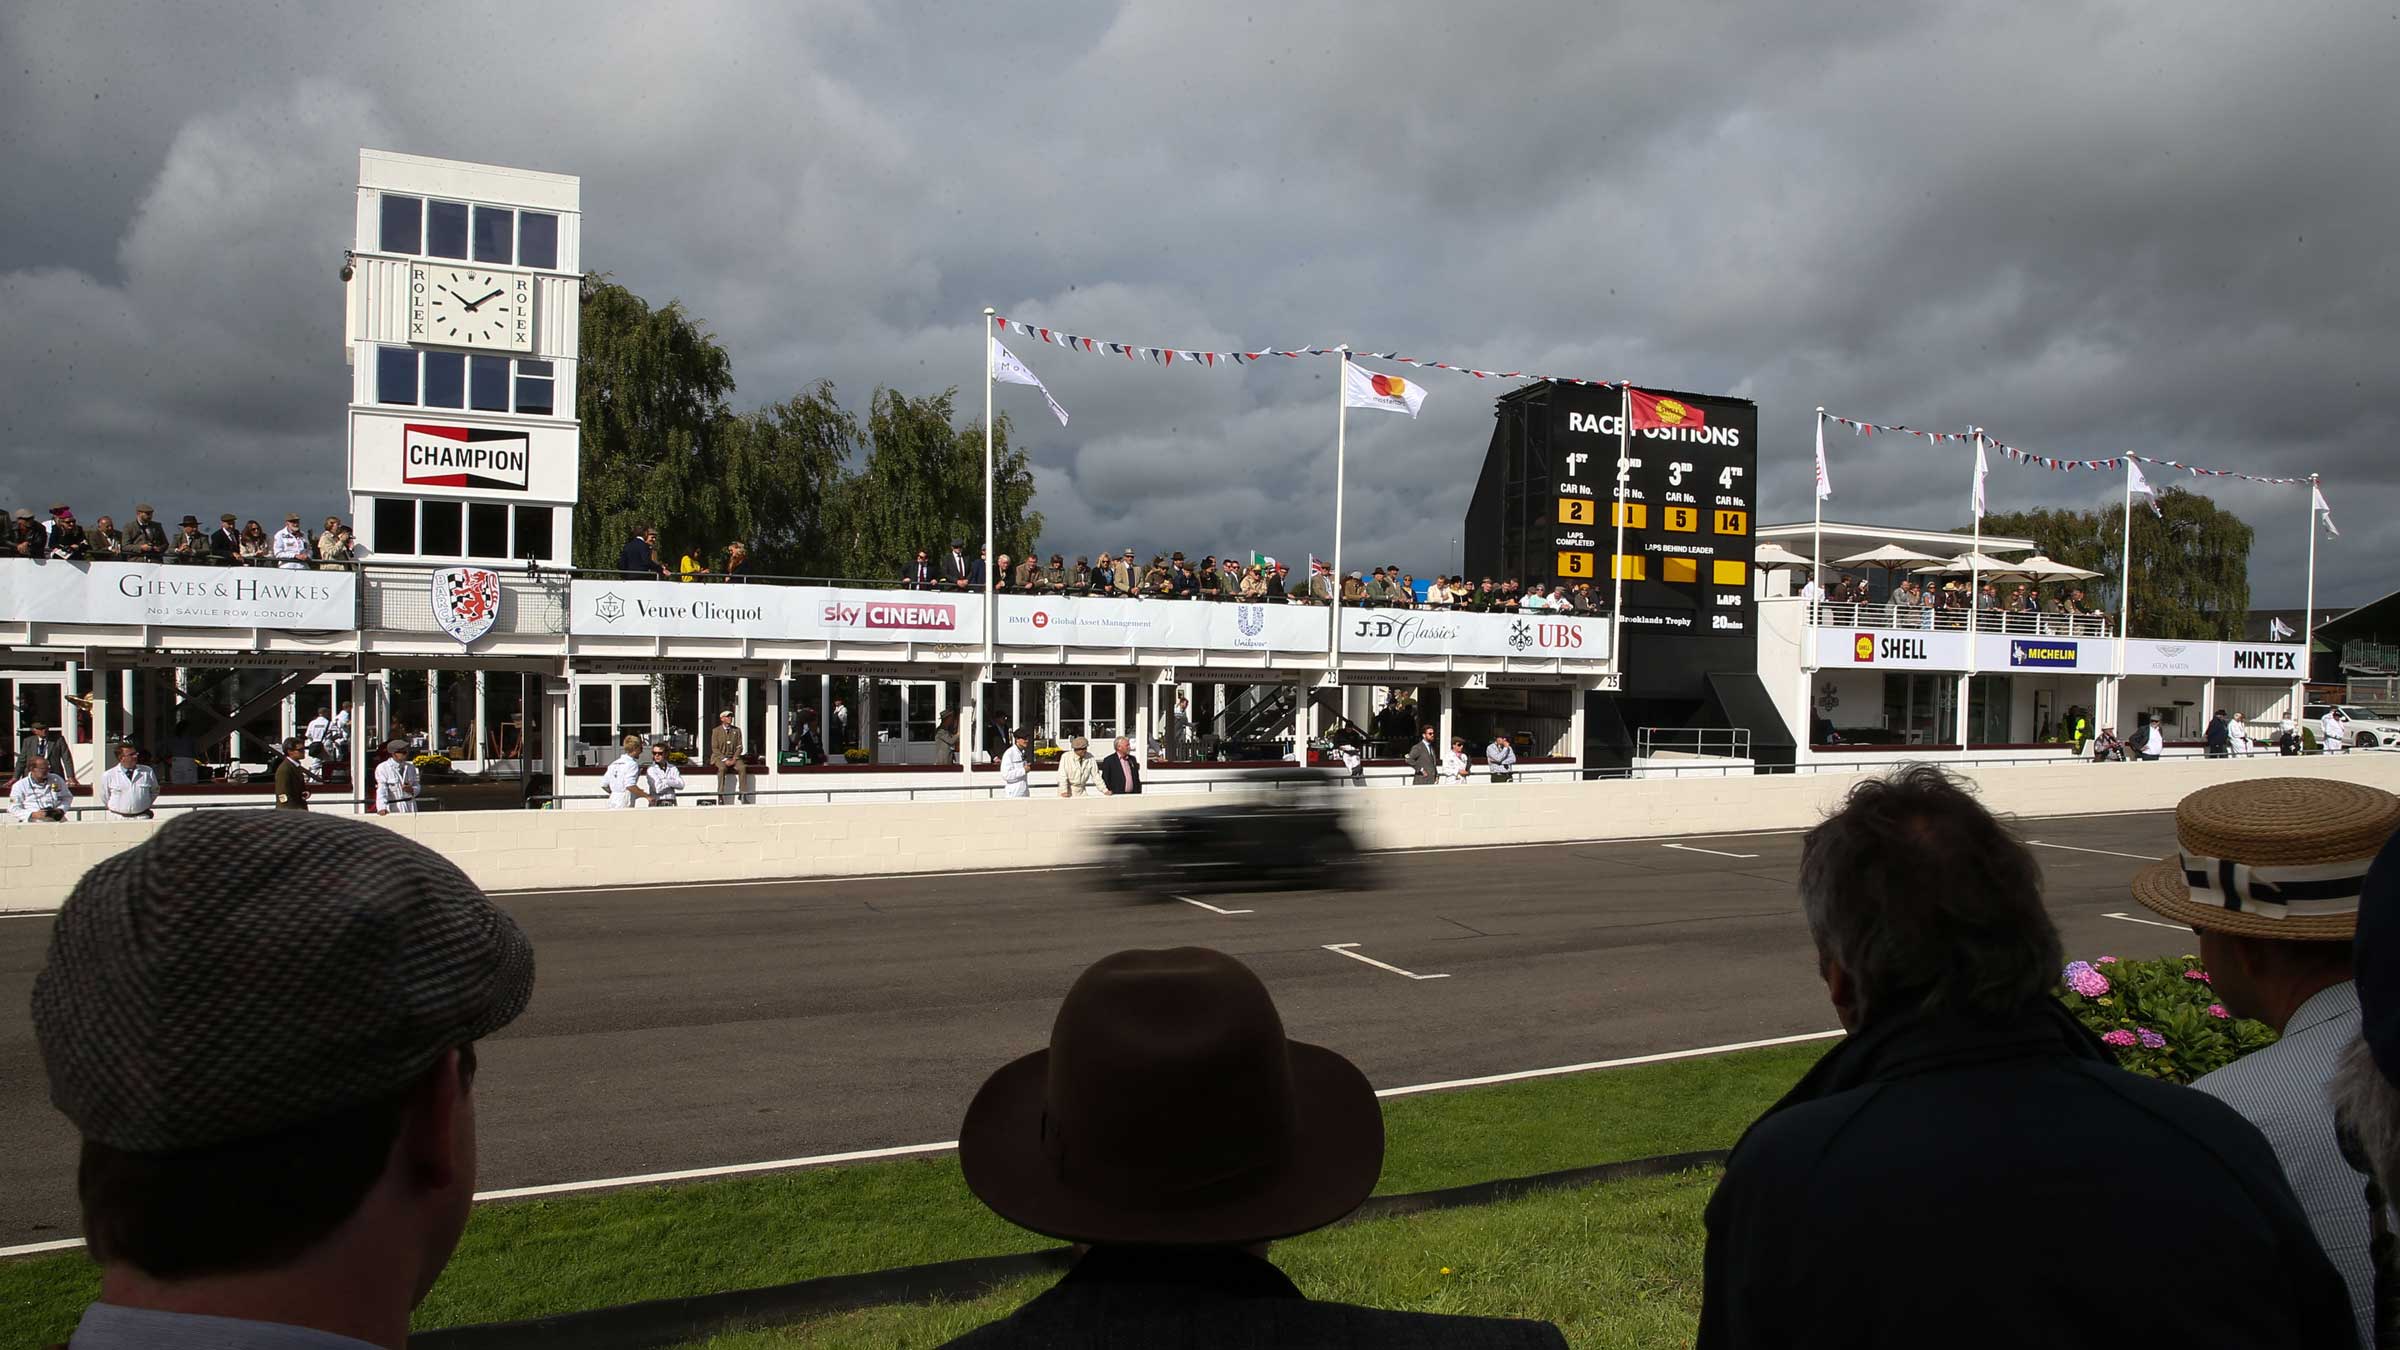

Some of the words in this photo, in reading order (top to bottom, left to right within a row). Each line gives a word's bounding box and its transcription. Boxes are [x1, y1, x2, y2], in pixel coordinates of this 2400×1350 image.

[413, 269, 424, 335] ROLEX
[516, 279, 527, 343] ROLEX
[1569, 412, 1624, 436] RACE
[410, 444, 524, 471] CHAMPION
[1566, 452, 1588, 477] 1ST
[1668, 461, 1693, 486] 3RD
[1719, 465, 1743, 489] 4TH
[1560, 482, 1578, 494] CAR
[1578, 484, 1593, 495] No.
[1631, 488, 1645, 499] No.
[1665, 491, 1683, 502] CAR
[1683, 493, 1696, 504] No.
[1715, 495, 1733, 506] CAR
[1733, 497, 1746, 507] No.
[1570, 501, 1582, 520] 2
[1627, 506, 1633, 524] 1
[1675, 510, 1686, 528] 5
[1722, 513, 1739, 531] 14
[1556, 538, 1595, 547] COMPLETED
[1567, 531, 1584, 540] LAPS
[1645, 543, 1661, 552] LAPS
[1662, 544, 1687, 553] BEHIND
[1688, 546, 1714, 555] LEADER
[1570, 555, 1581, 573] 5
[119, 574, 206, 598] GIEVES
[214, 583, 228, 598] &
[236, 578, 330, 601] HAWKES
[435, 574, 449, 621] BARC
[1716, 594, 1742, 606] LAPS
[175, 608, 218, 616] SAVILE
[223, 609, 249, 617] ROW
[254, 610, 304, 618] LONDON
[637, 599, 686, 620] Veuve
[691, 601, 763, 624] Clicquot
[823, 602, 861, 626] sky
[870, 606, 950, 626] CINEMA
[1008, 616, 1030, 624] BMO
[1050, 617, 1077, 625] Global
[1077, 618, 1100, 626] Asset
[1101, 619, 1151, 629] Management
[1618, 615, 1663, 625] Brooklands
[1665, 616, 1692, 627] Trophy
[1354, 621, 1393, 638] J.D
[1395, 616, 1458, 649] Classics
[1537, 623, 1583, 649] UBS
[1233, 638, 1268, 648] Unilever
[1880, 637, 1928, 660] SHELL
[2028, 647, 2076, 661] MICHELIN
[2233, 649, 2296, 671] MINTEX
[1164, 668, 1173, 682] 22
[1327, 672, 1337, 684] 23
[1473, 674, 1483, 686] 24
[1607, 676, 1618, 688] 25
